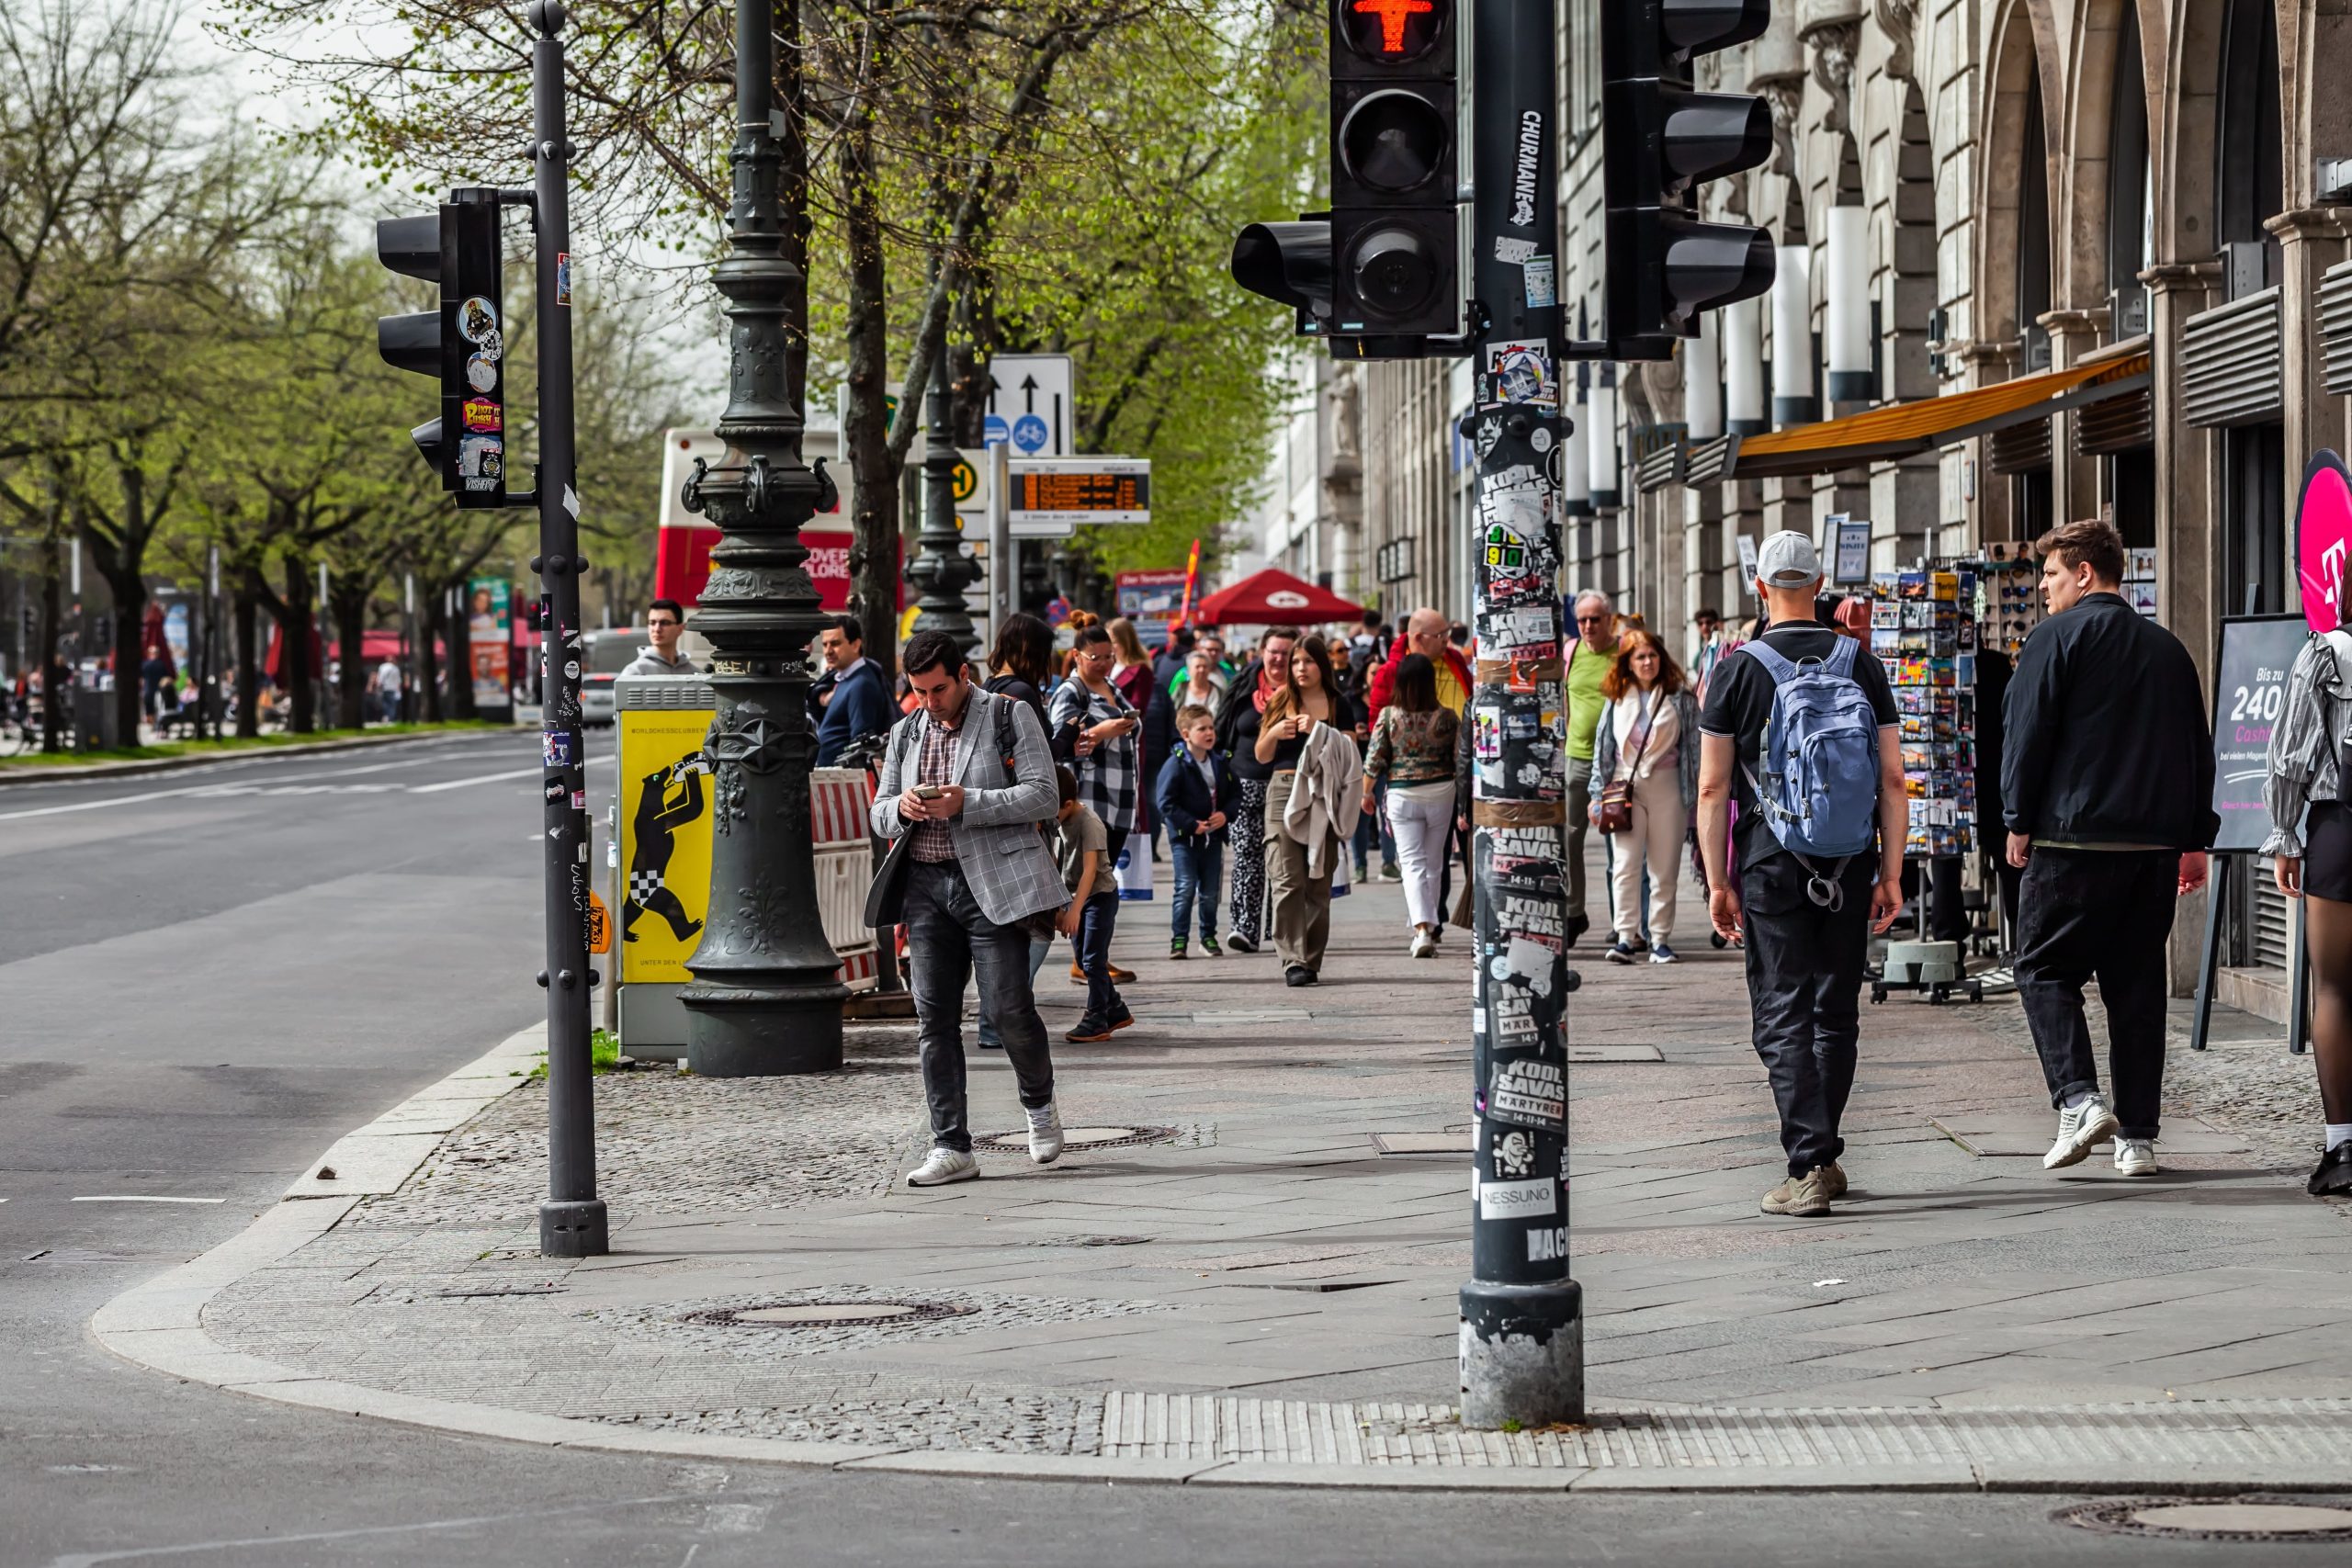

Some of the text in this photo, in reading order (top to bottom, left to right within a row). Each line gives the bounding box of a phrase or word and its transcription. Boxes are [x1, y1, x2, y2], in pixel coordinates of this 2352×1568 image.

[1515, 110, 1542, 202] CHURMANE
[2256, 667, 2284, 682] Bis zu
[2231, 684, 2282, 721] 240
[1494, 838, 1561, 861] SAVAS
[1508, 1060, 1563, 1084] KOOL
[1498, 1074, 1565, 1101] SAVAS
[1484, 1187, 1550, 1205] NESSUNO
